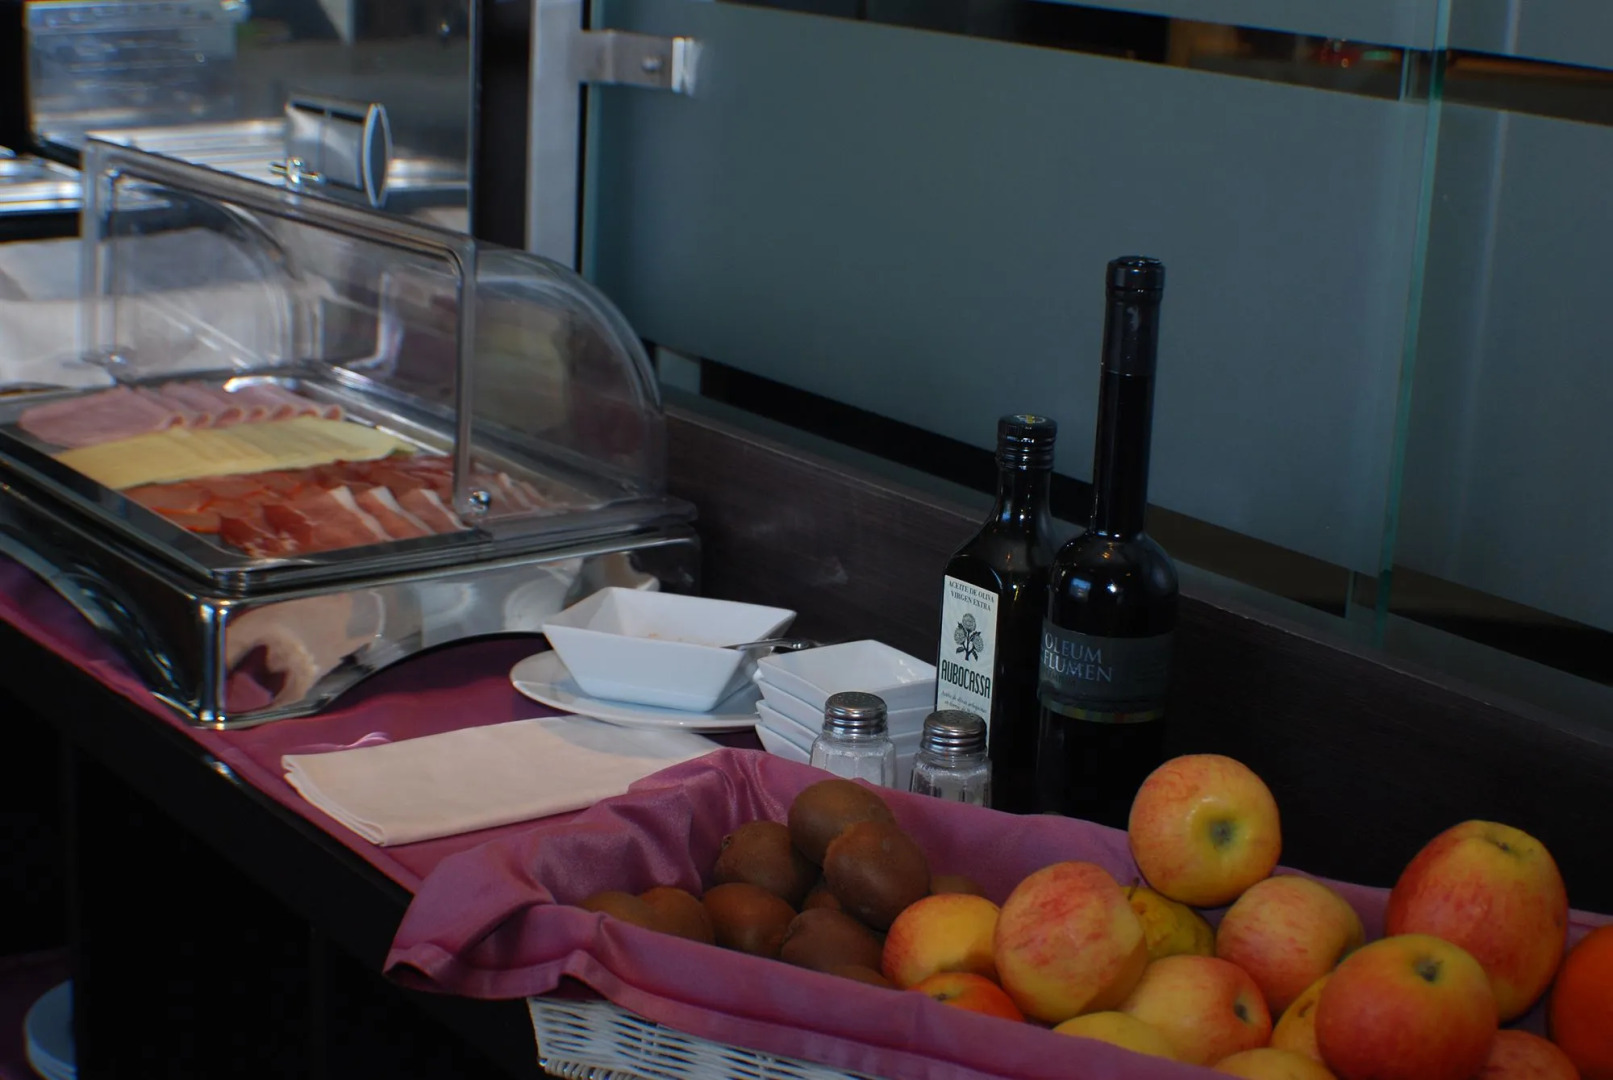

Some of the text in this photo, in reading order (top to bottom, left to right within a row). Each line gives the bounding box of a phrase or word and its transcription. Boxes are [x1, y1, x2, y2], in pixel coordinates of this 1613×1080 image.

[949, 581, 994, 603] ACEITE DE OLIVA
[951, 591, 991, 612] VIRGEN EXTRA
[1045, 632, 1102, 664] OLEUM
[941, 659, 991, 699] AUBOCASSA
[1044, 649, 1112, 683] FLUMEN
